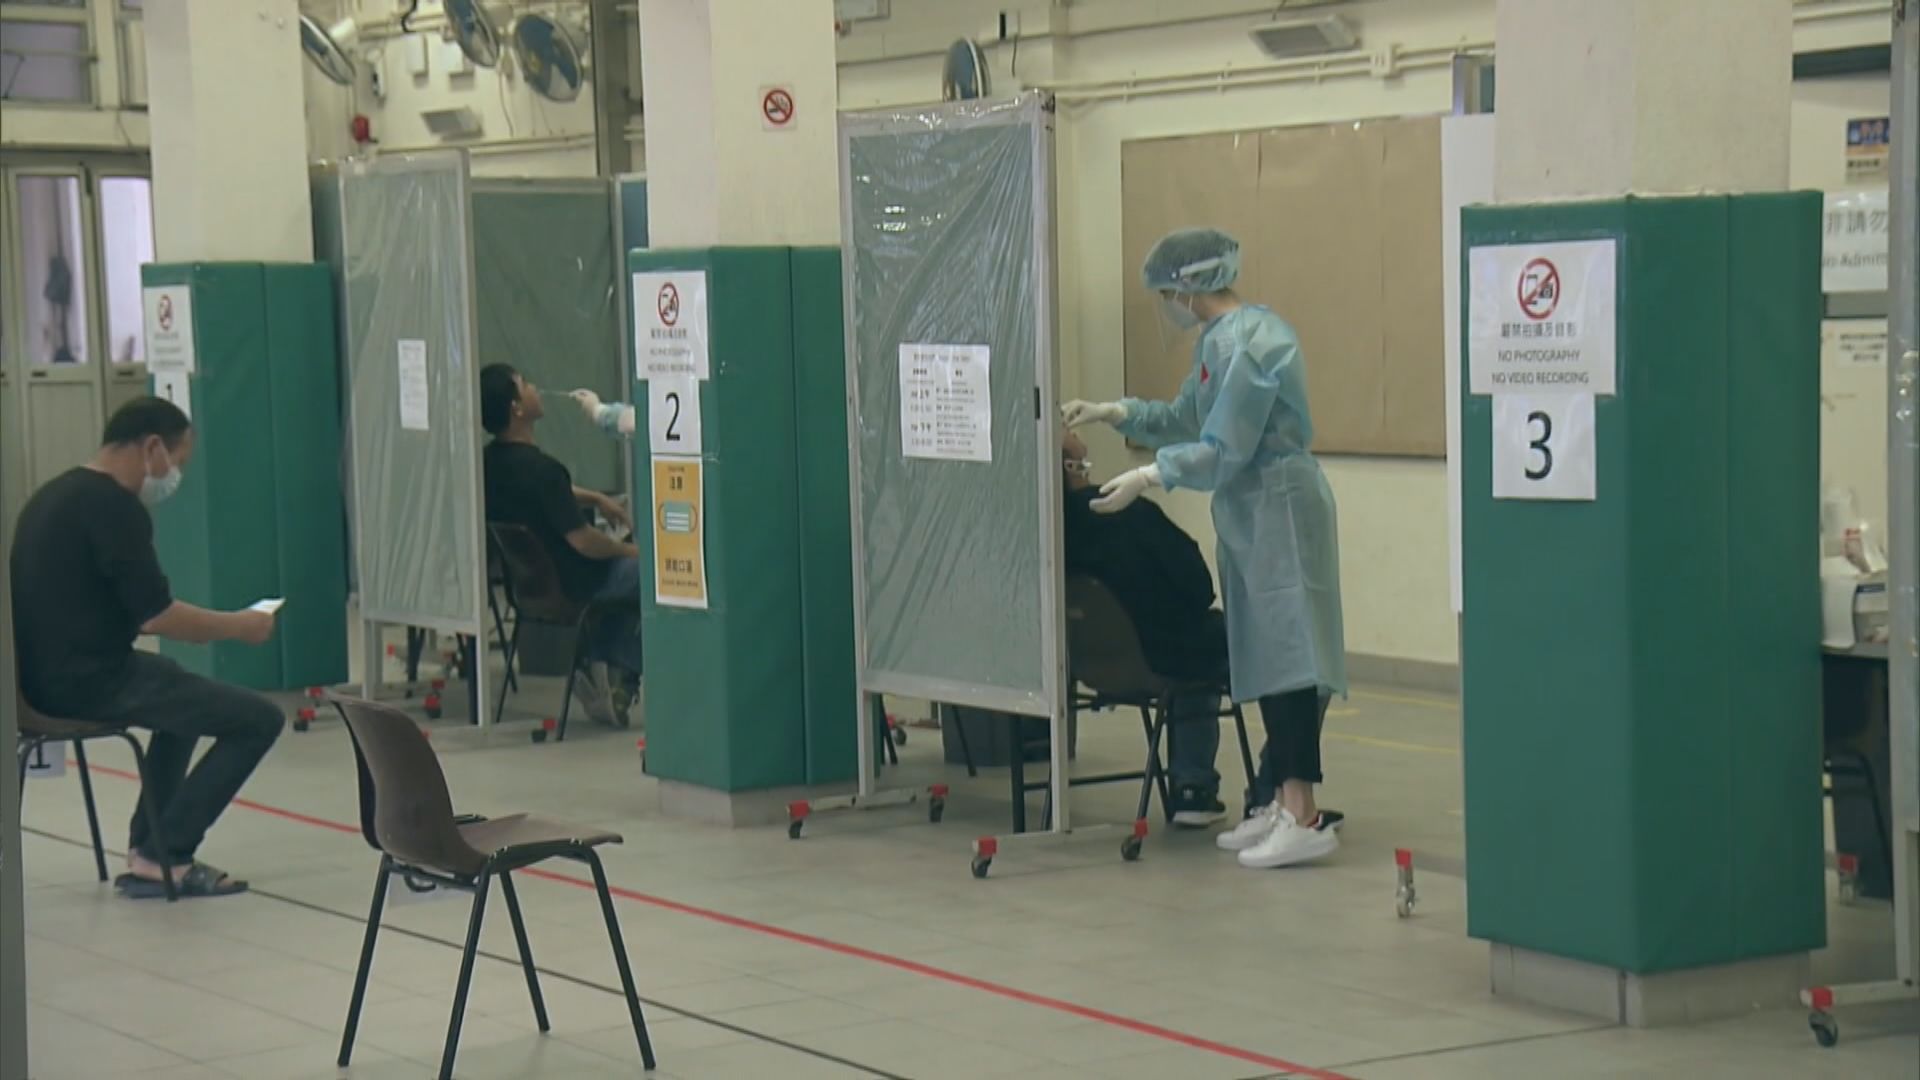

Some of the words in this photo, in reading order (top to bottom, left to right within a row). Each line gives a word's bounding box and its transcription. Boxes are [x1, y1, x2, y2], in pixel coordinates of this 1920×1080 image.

[1498, 350, 1513, 361] NO
[1514, 349, 1580, 361] PHOTOGRAPHY
[1492, 372, 1506, 384] NO
[1508, 371, 1534, 384] VIDEO
[1536, 371, 1589, 384] RECORDING
[665, 392, 681, 441] 2
[1525, 411, 1553, 480] 3
